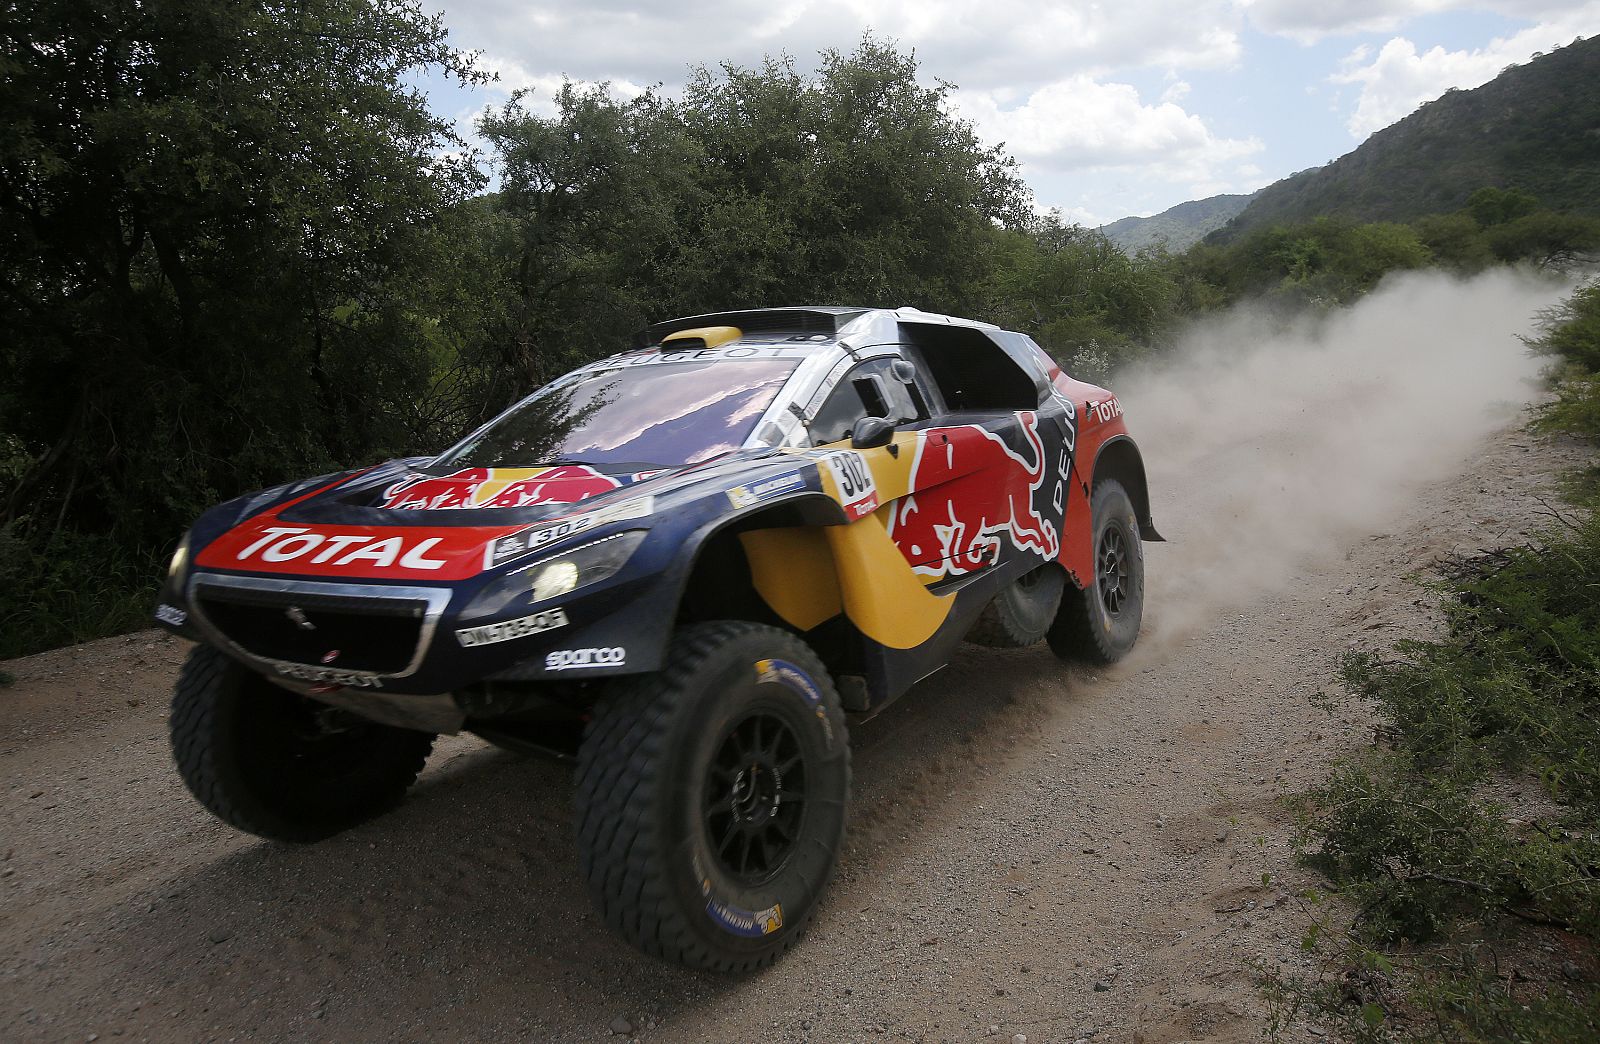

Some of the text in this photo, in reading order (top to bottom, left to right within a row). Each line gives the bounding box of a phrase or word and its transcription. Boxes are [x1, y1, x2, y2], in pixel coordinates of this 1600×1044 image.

[588, 346, 797, 371] PEUGEOT
[1090, 398, 1124, 424] TOTA
[832, 452, 871, 497] 302
[536, 517, 592, 543] 302
[236, 527, 448, 570] TOTAL
[545, 646, 626, 671] sparco
